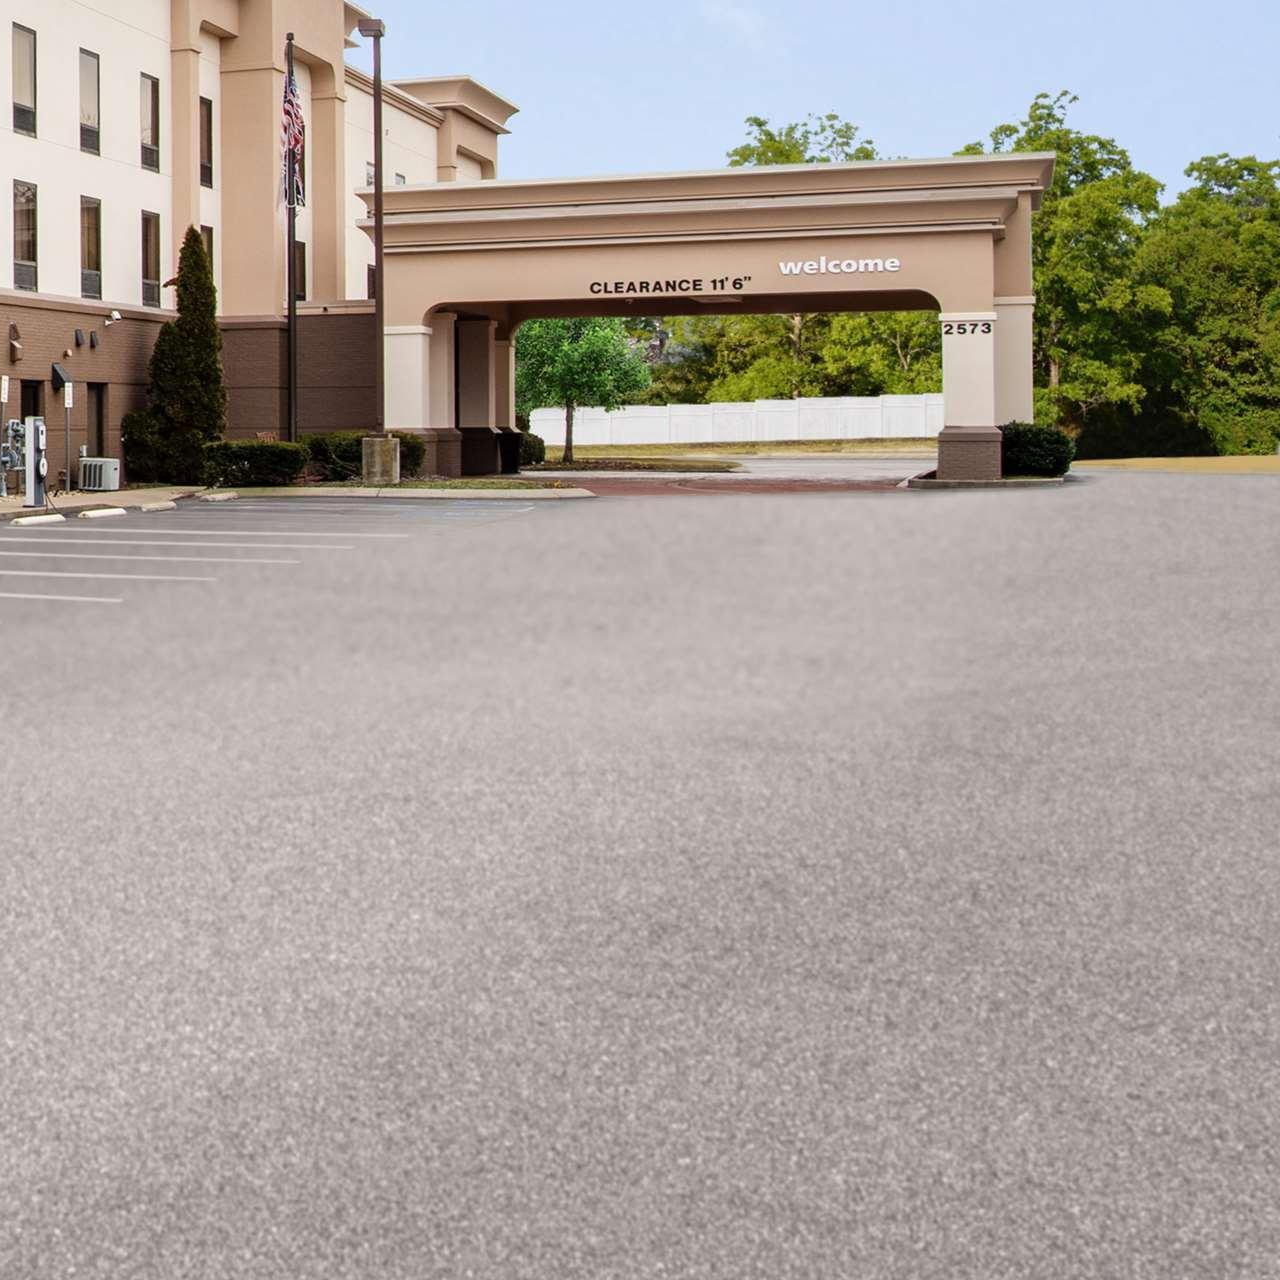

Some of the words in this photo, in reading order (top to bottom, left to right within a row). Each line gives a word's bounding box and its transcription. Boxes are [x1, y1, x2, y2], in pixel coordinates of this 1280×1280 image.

[778, 255, 901, 275] welcome
[589, 278, 704, 295] CLEARANCE
[943, 322, 992, 335] 2573
